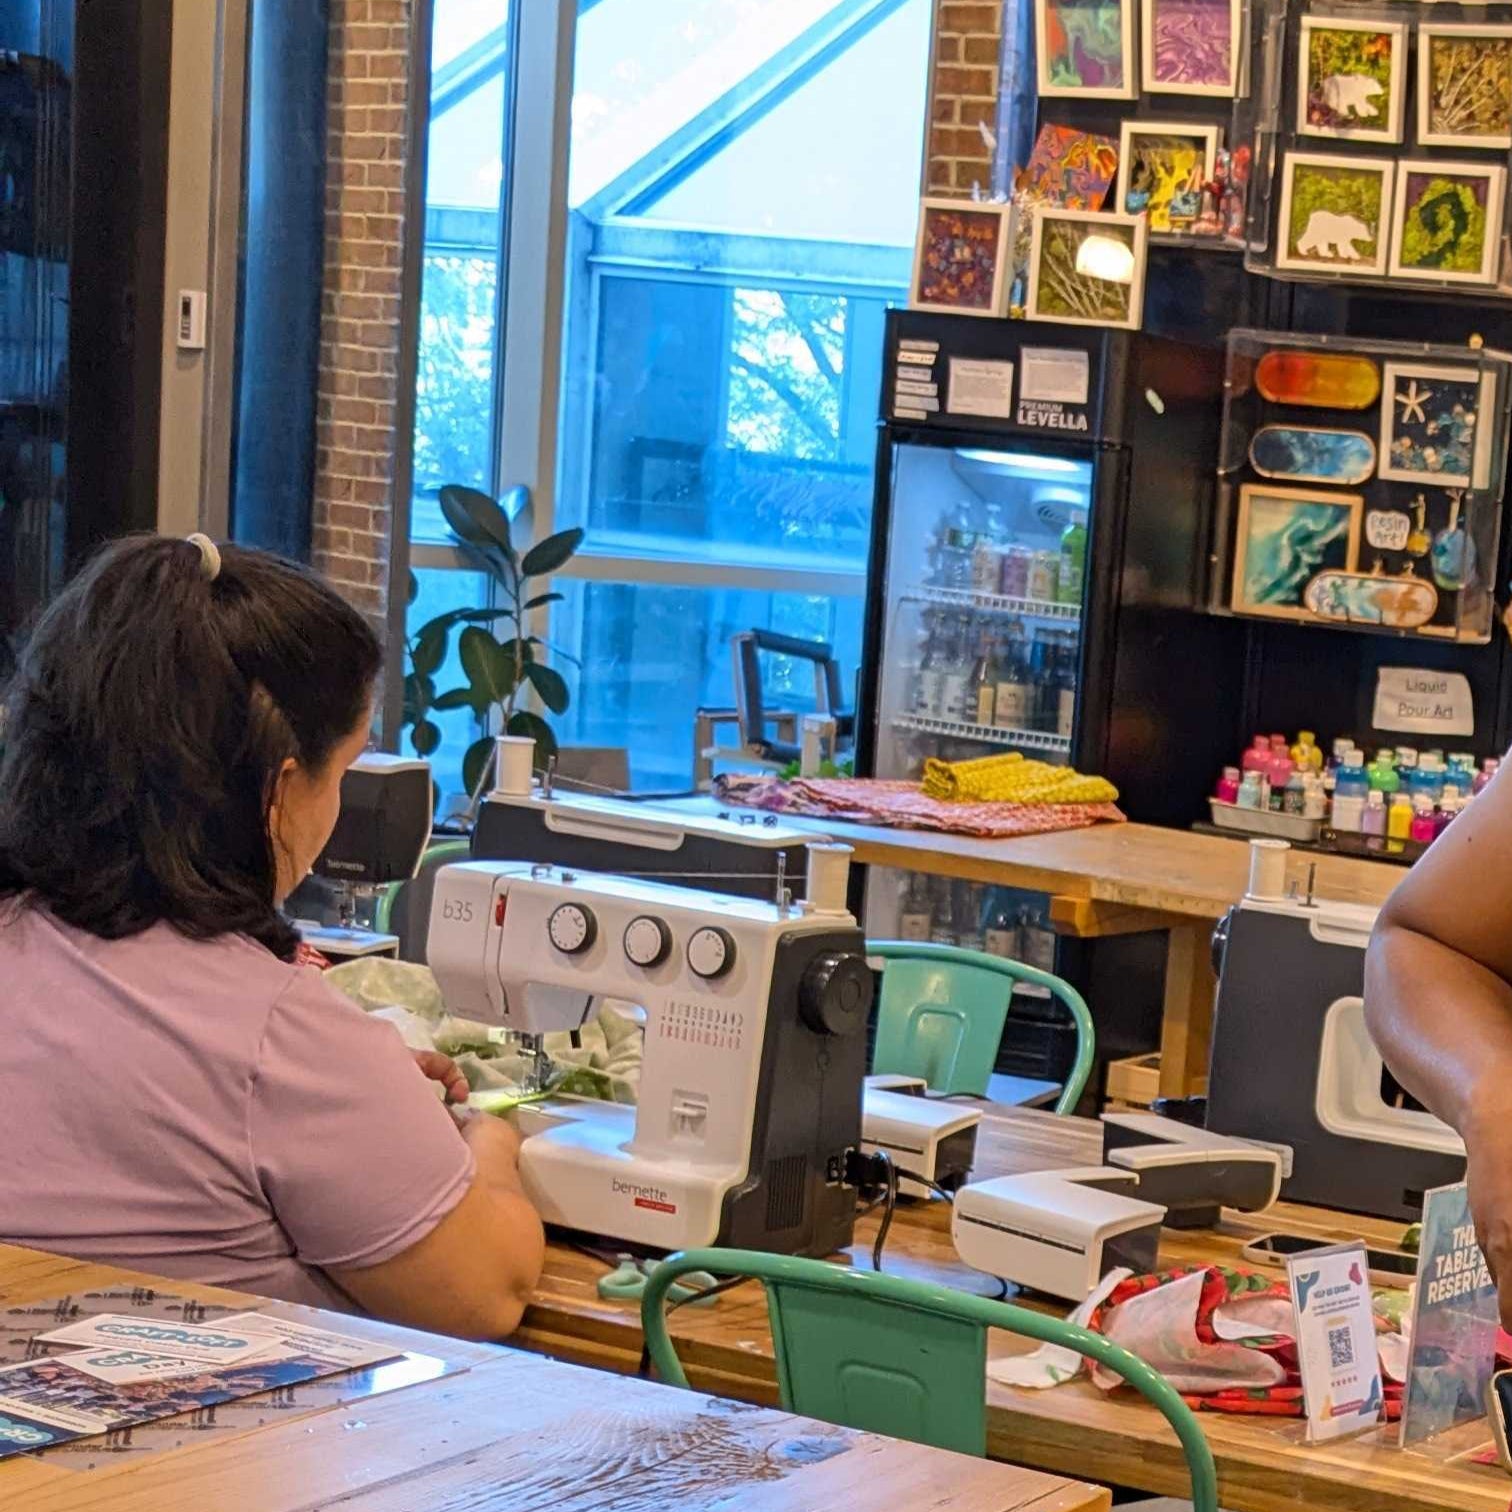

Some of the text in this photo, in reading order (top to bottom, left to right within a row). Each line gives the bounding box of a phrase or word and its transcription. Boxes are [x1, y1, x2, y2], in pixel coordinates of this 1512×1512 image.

[1019, 401, 1063, 413] PREMIUM
[1017, 410, 1088, 431] LEVELLA
[1397, 702, 1430, 717] Pour
[442, 900, 474, 922] b35
[612, 1178, 668, 1201] bernette
[1436, 1245, 1479, 1279] TABLE
[1427, 1265, 1494, 1305] RESERVE
